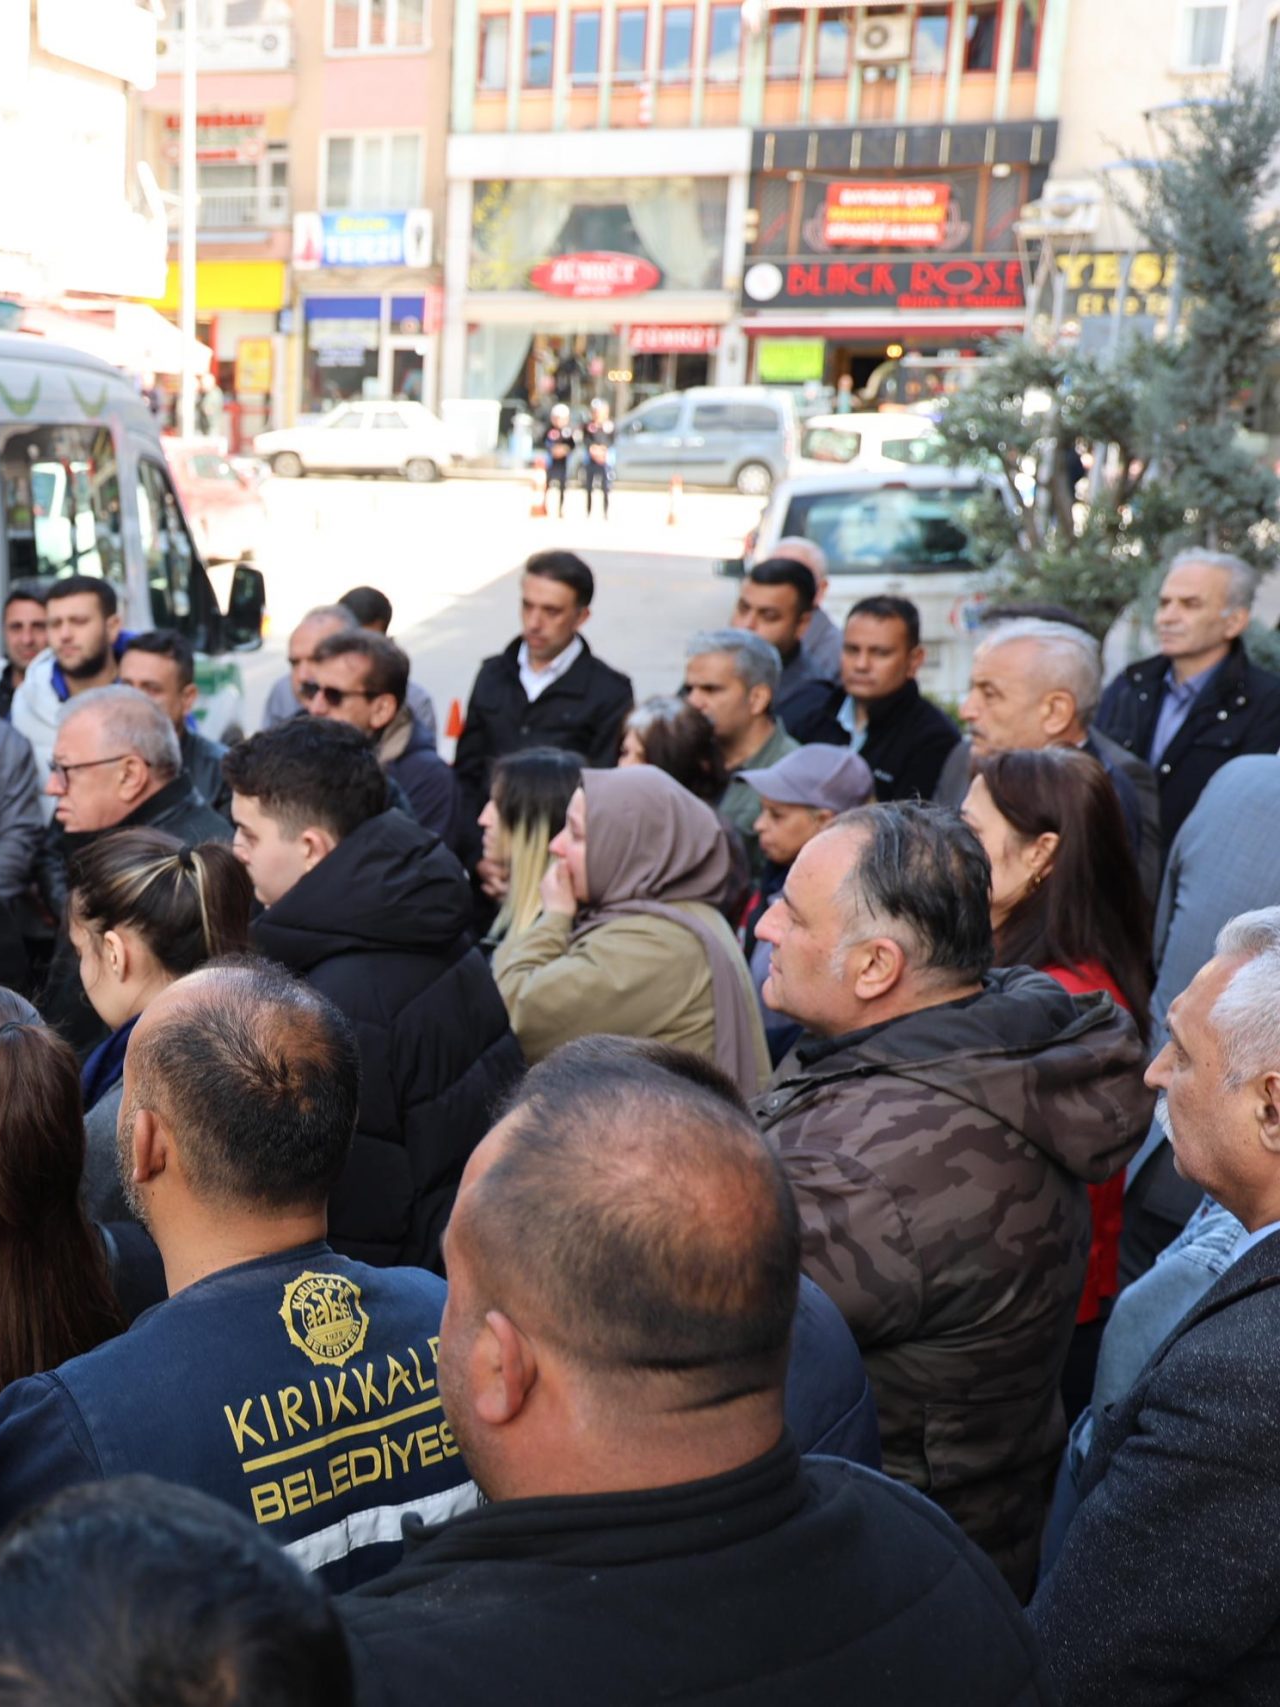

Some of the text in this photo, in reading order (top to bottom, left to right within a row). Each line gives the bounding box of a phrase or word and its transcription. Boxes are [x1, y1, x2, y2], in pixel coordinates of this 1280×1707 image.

[785, 260, 1022, 296] BLACK ROSE
[291, 1278, 352, 1311] KIRIKKALE
[249, 1419, 460, 1525] BELEDİYES
